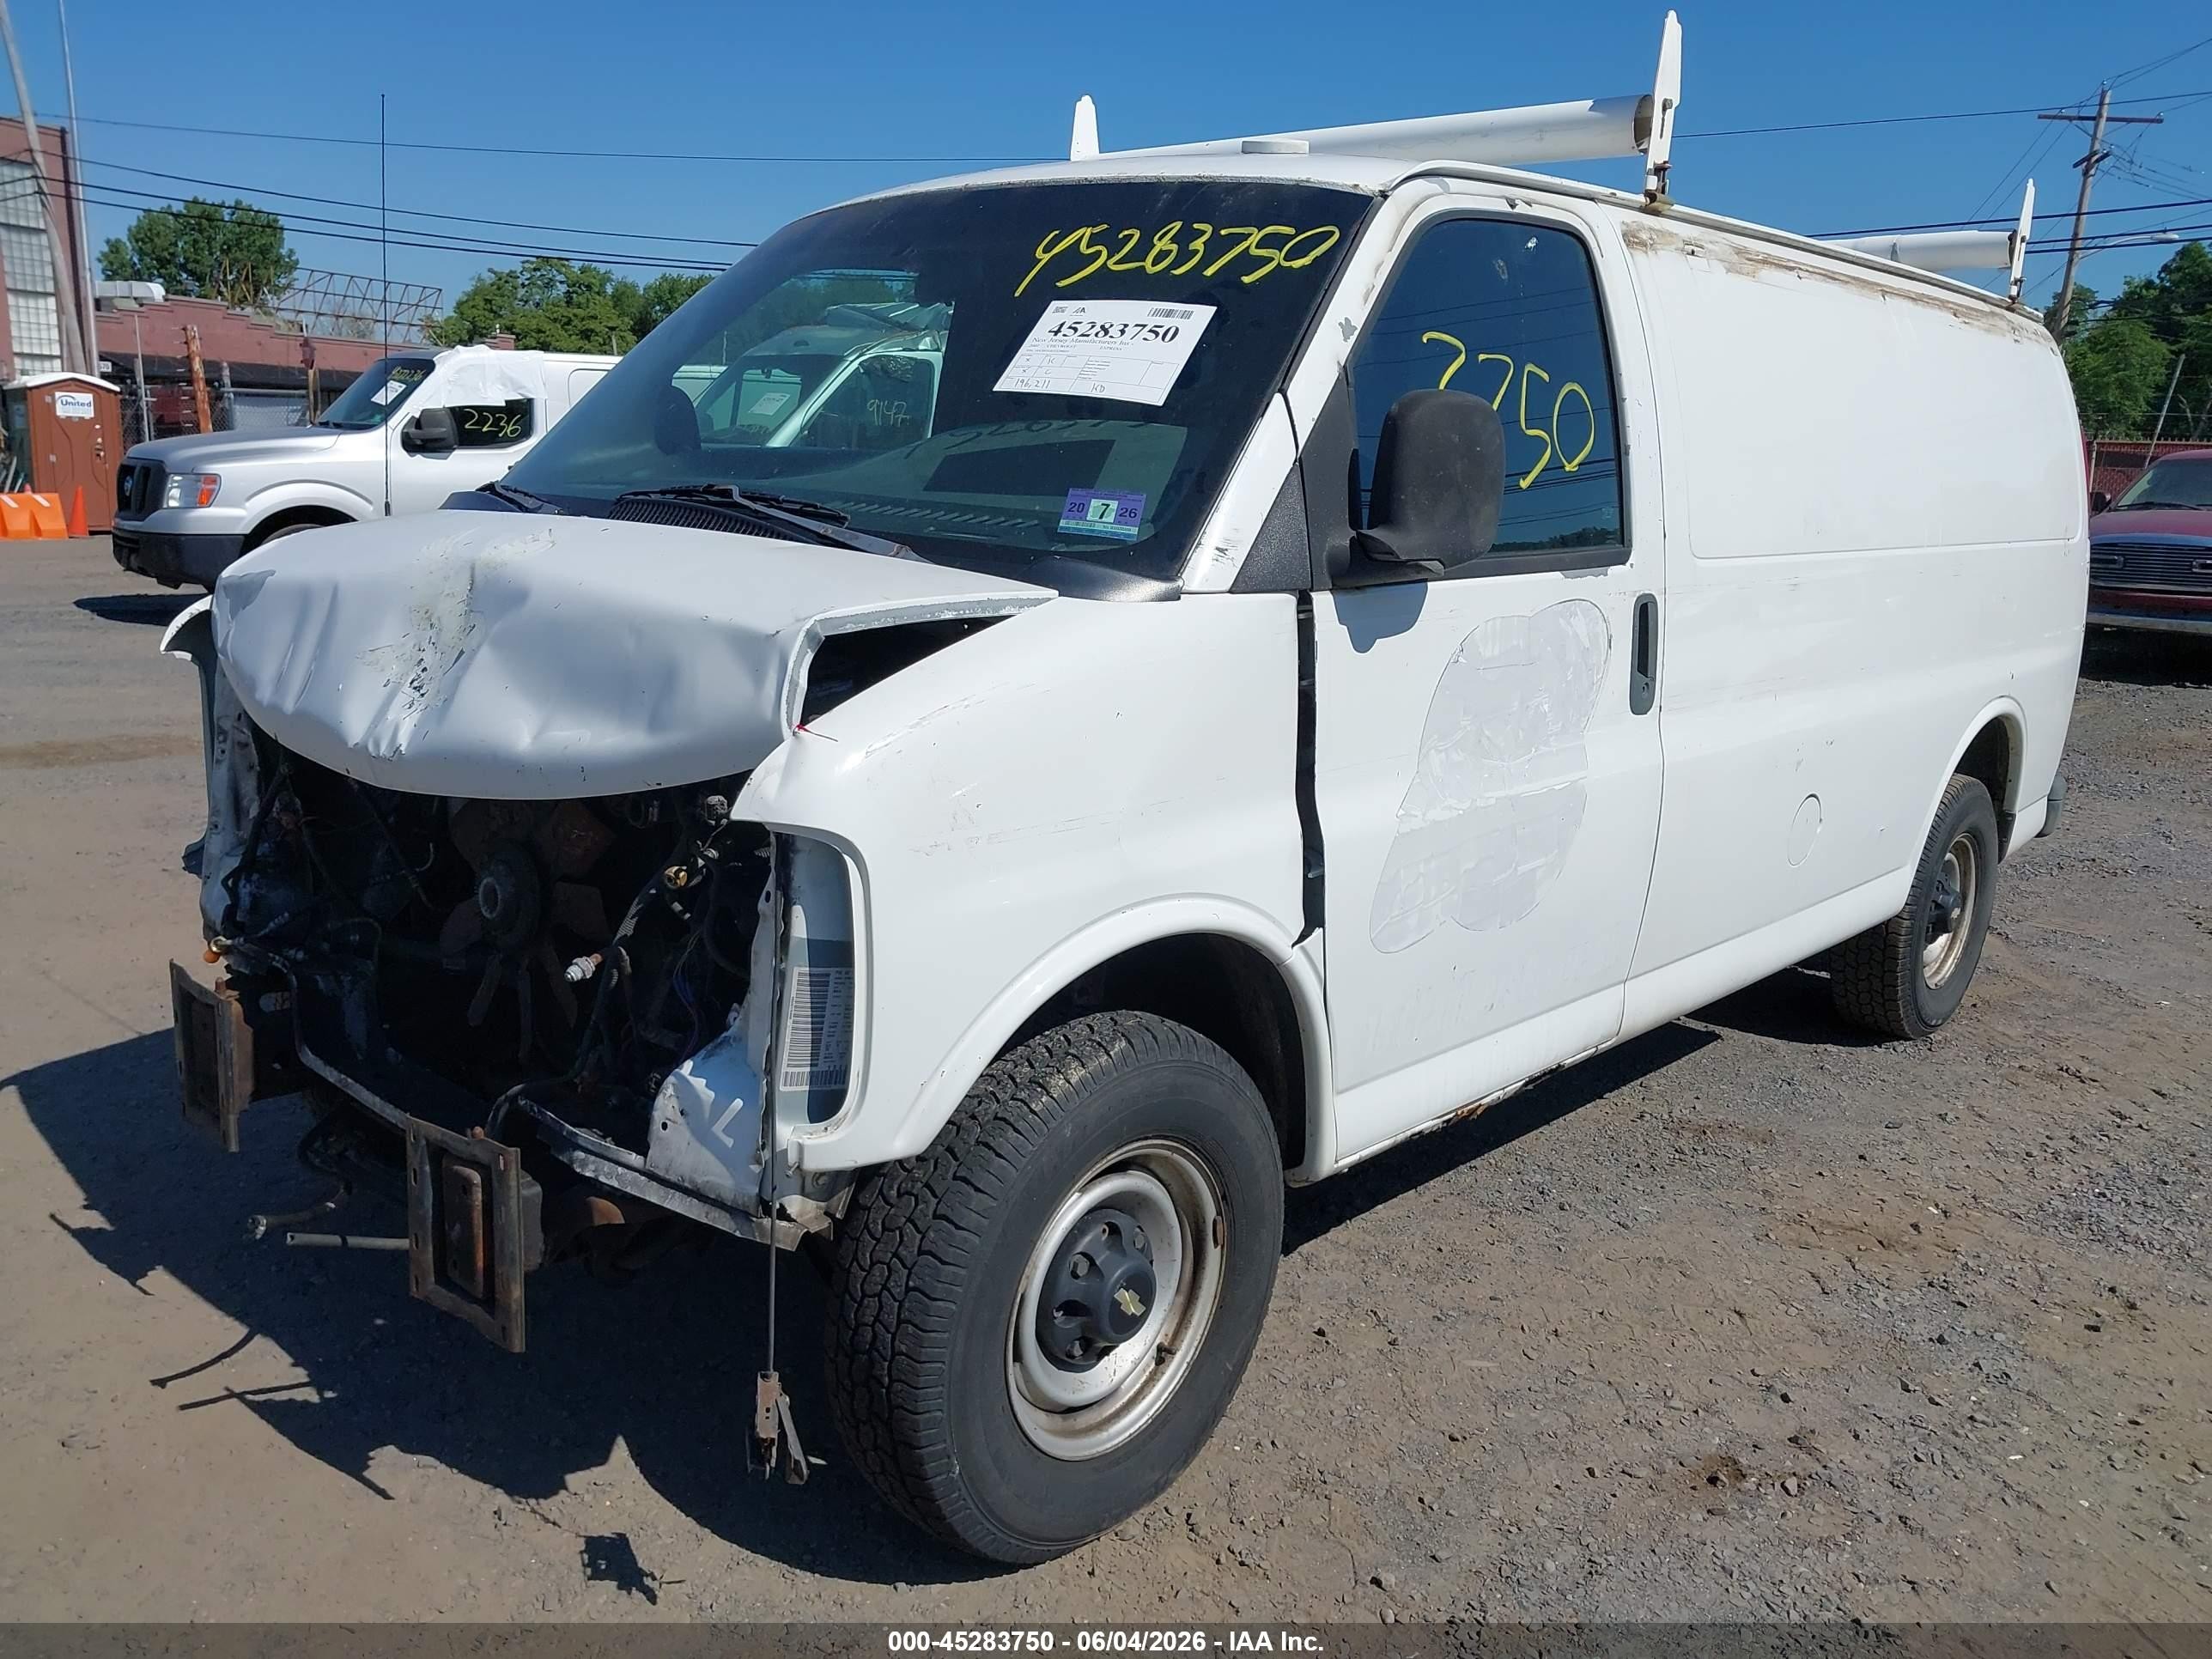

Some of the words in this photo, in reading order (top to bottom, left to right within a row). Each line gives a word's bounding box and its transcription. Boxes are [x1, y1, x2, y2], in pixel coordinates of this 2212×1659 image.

[1014, 220, 1340, 297] 45283750
[1048, 320, 1181, 343] 45283750
[1048, 337, 1068, 345] Jersey
[61, 398, 92, 408] United
[464, 408, 522, 438] 2236
[1068, 502, 1085, 514] 20
[1099, 503, 1110, 520] 7
[1119, 507, 1138, 519] 26
